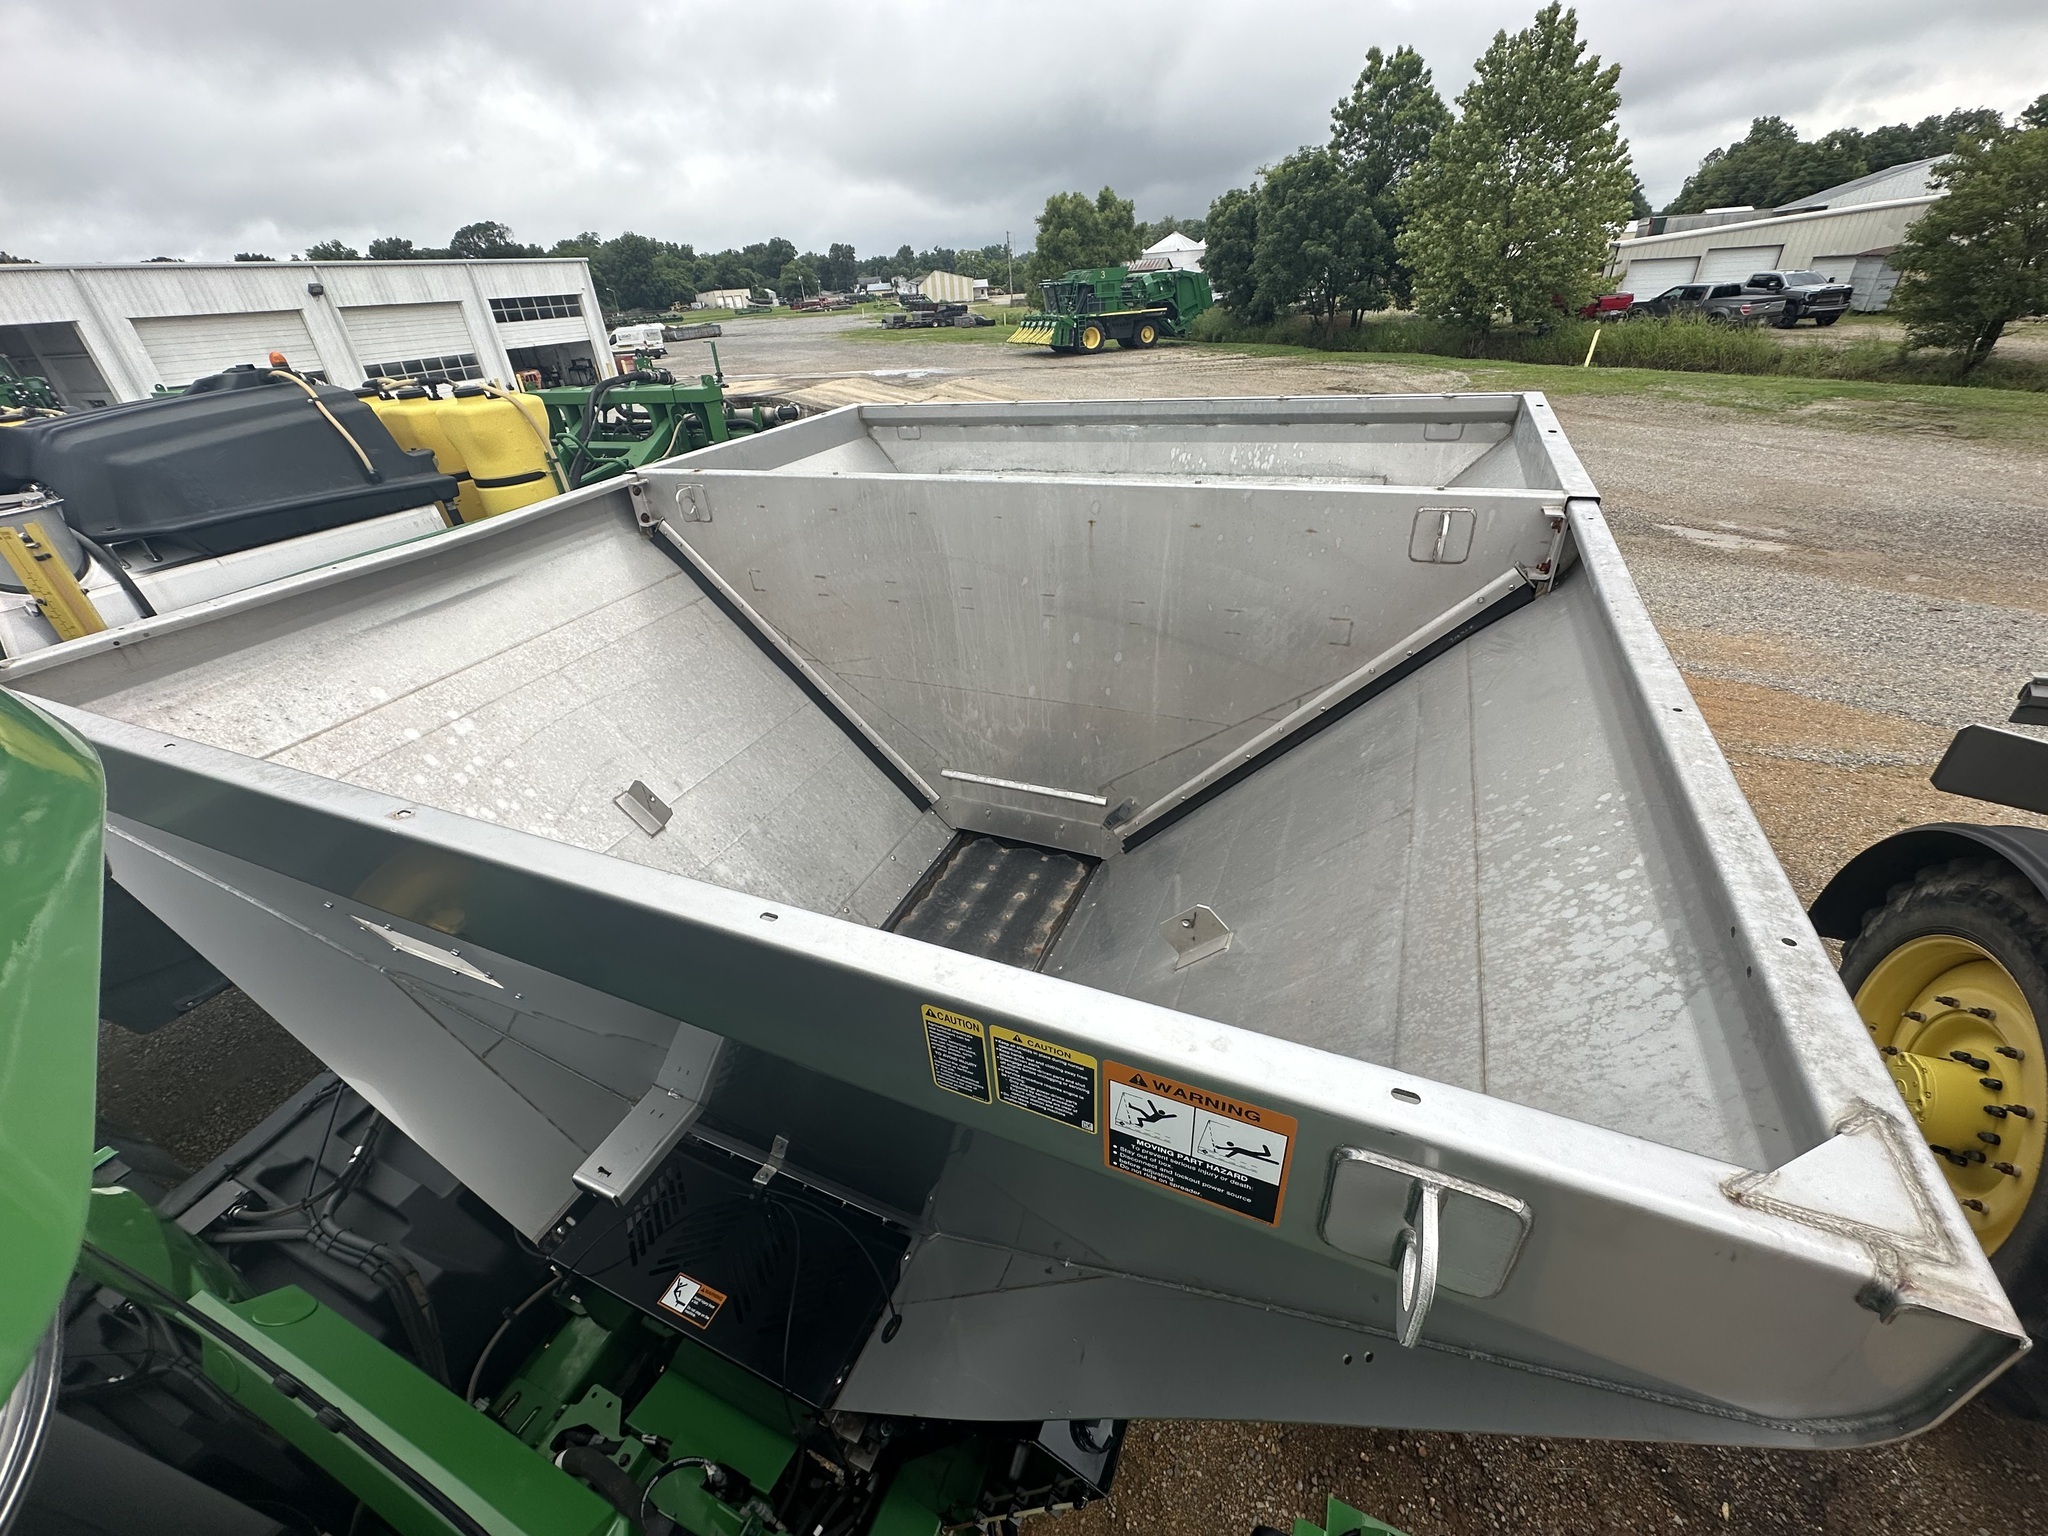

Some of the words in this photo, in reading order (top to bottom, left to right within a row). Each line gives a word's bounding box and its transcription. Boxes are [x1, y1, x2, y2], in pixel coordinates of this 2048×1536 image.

[1101, 271, 1106, 279] 3
[936, 1011, 979, 1032] CAUTION
[1027, 1039, 1071, 1059] CAUTION
[1152, 1080, 1262, 1123] WARNING
[1119, 1157, 1141, 1169] before
[1120, 1146, 1135, 1157] Stay
[1137, 1152, 1148, 1160] out
[1131, 1143, 1140, 1152] To
[1142, 1148, 1168, 1162] prevent
[1170, 1158, 1196, 1171] serious
[1198, 1168, 1219, 1180] injury
[1137, 1139, 1174, 1157] MOVING
[1177, 1153, 1203, 1167] PART
[1206, 1163, 1248, 1183] HAZARD
[1120, 1152, 1158, 1170] Disconnect
[1160, 1166, 1173, 1175] and
[1175, 1172, 1200, 1185] lockout
[1202, 1182, 1225, 1194] power
[1226, 1190, 1252, 1204] source
[1120, 1163, 1129, 1171] Do
[1131, 1167, 1142, 1175] not
[1143, 1172, 1157, 1181] ride
[1169, 1181, 1203, 1197] spreader.
